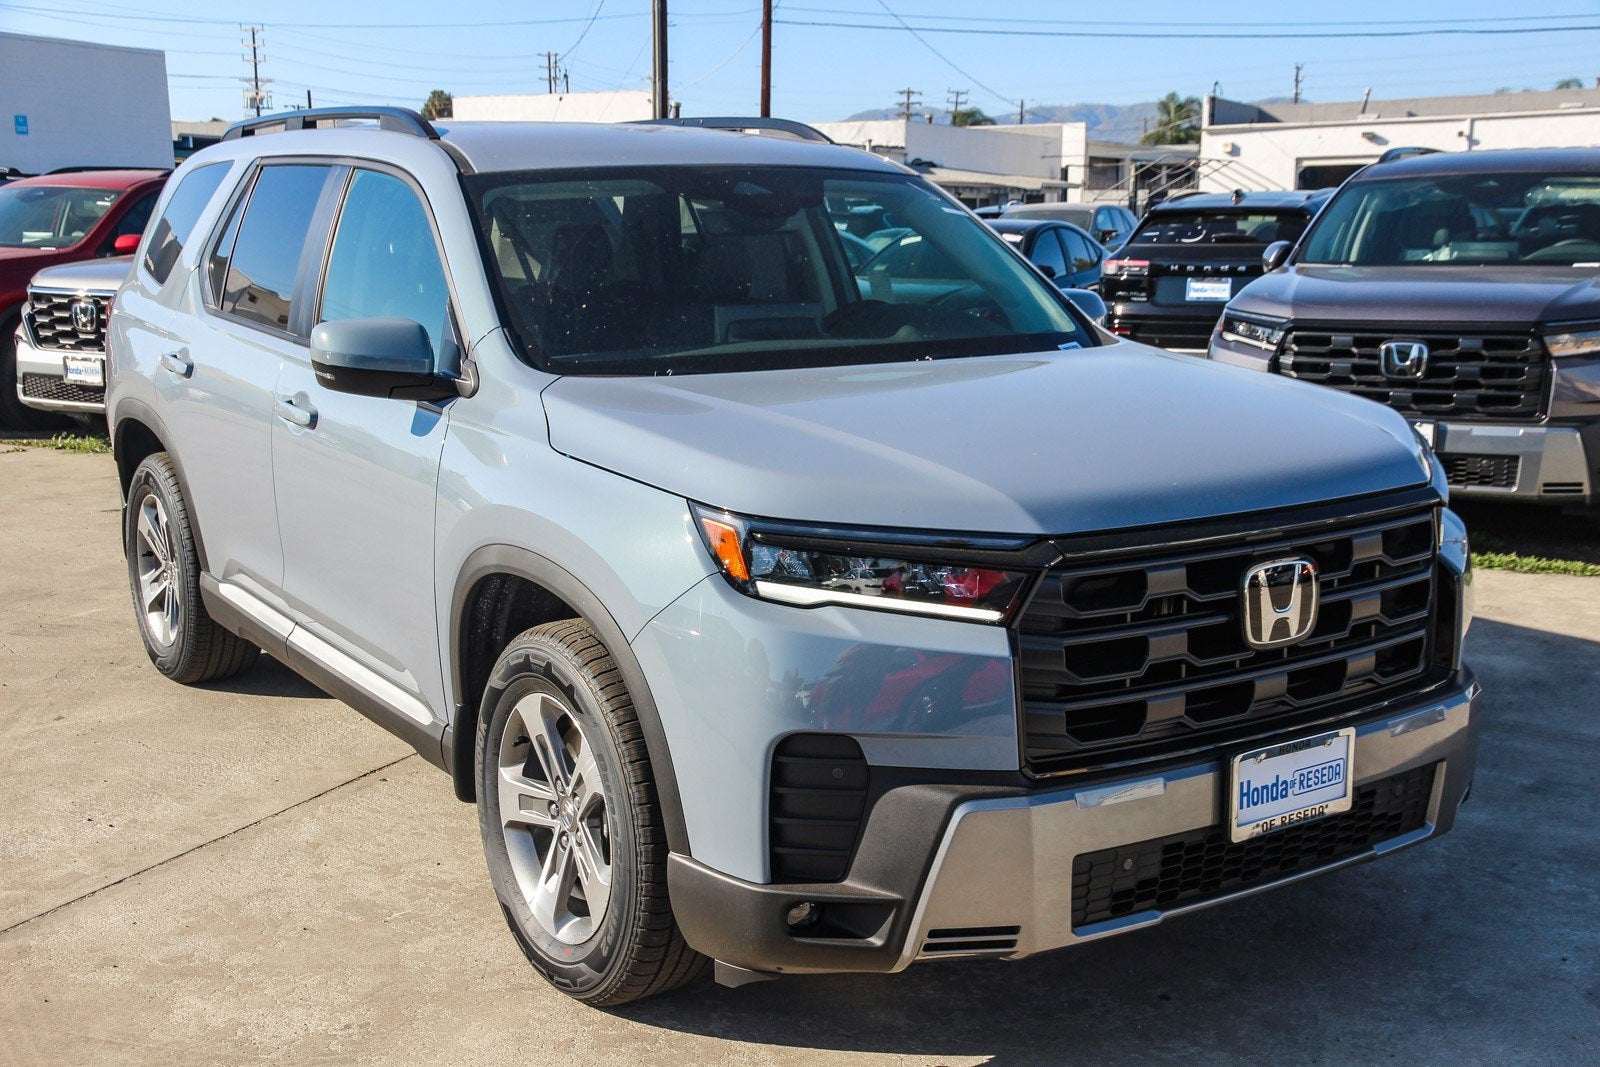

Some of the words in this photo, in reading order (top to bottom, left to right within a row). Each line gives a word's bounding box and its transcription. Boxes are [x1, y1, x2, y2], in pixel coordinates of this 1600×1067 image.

[1279, 740, 1312, 755] HONDA
[1239, 775, 1289, 810] Honda
[1289, 778, 1298, 790] OF
[1298, 763, 1342, 791] RESEDA
[1261, 819, 1276, 833] OF
